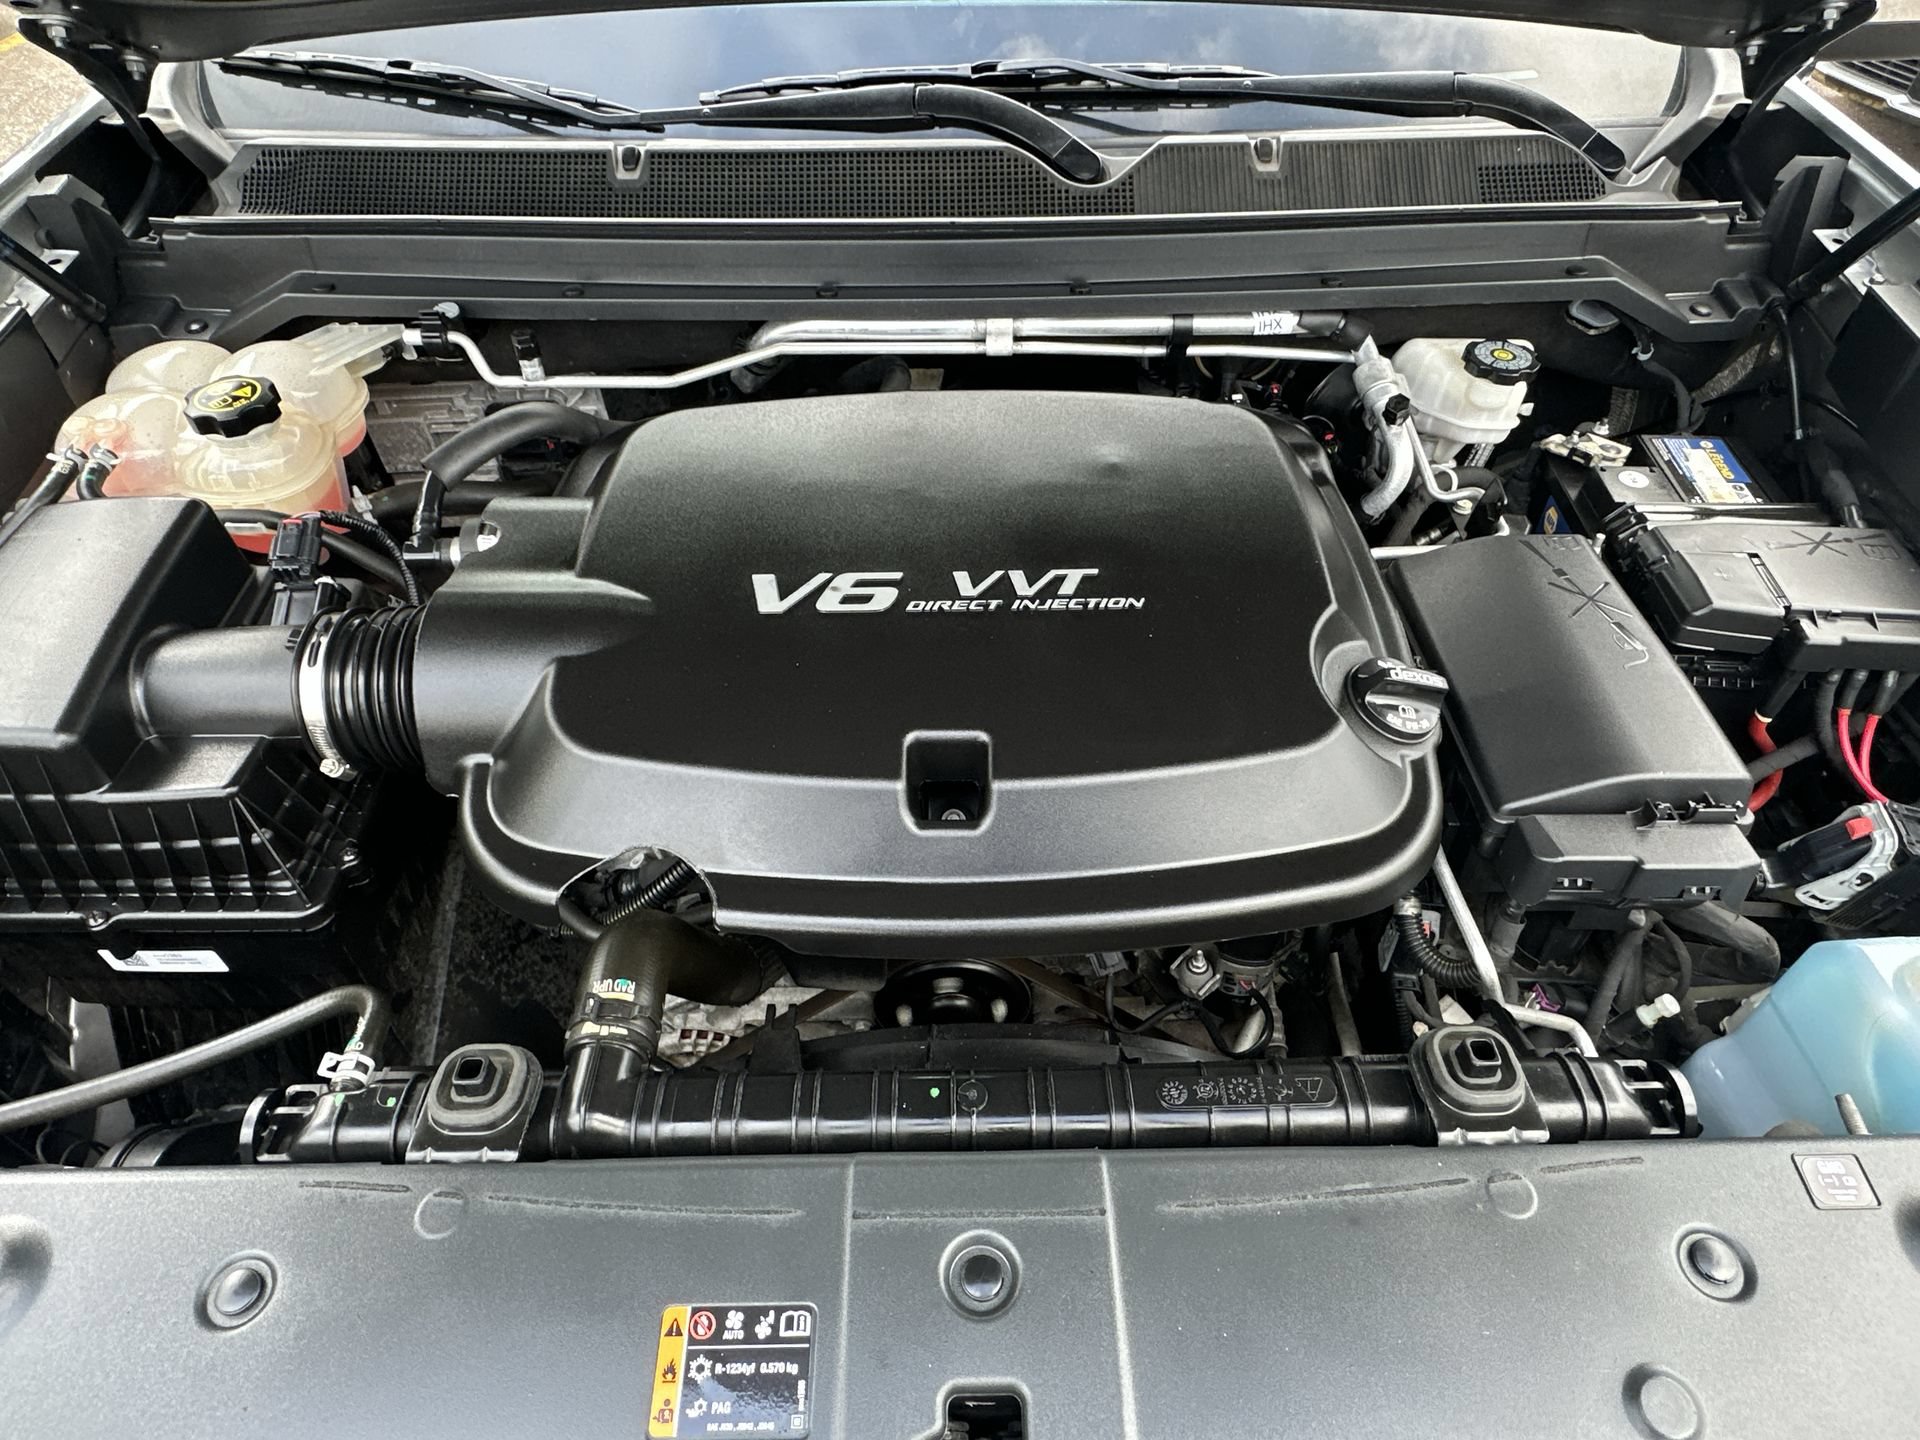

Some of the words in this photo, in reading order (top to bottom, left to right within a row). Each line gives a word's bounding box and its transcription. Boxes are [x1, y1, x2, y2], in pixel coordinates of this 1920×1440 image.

[952, 568, 1099, 597] VVT
[751, 571, 903, 614] V6
[905, 599, 1003, 612] DIRECT
[1011, 597, 1145, 611] INJECTION
[592, 979, 613, 993] UPR
[613, 979, 636, 993] RAD
[722, 1330, 744, 1340] AUTO
[714, 1362, 756, 1376] R-1234yf
[786, 1361, 799, 1376] kg
[711, 1401, 731, 1415] PAG
